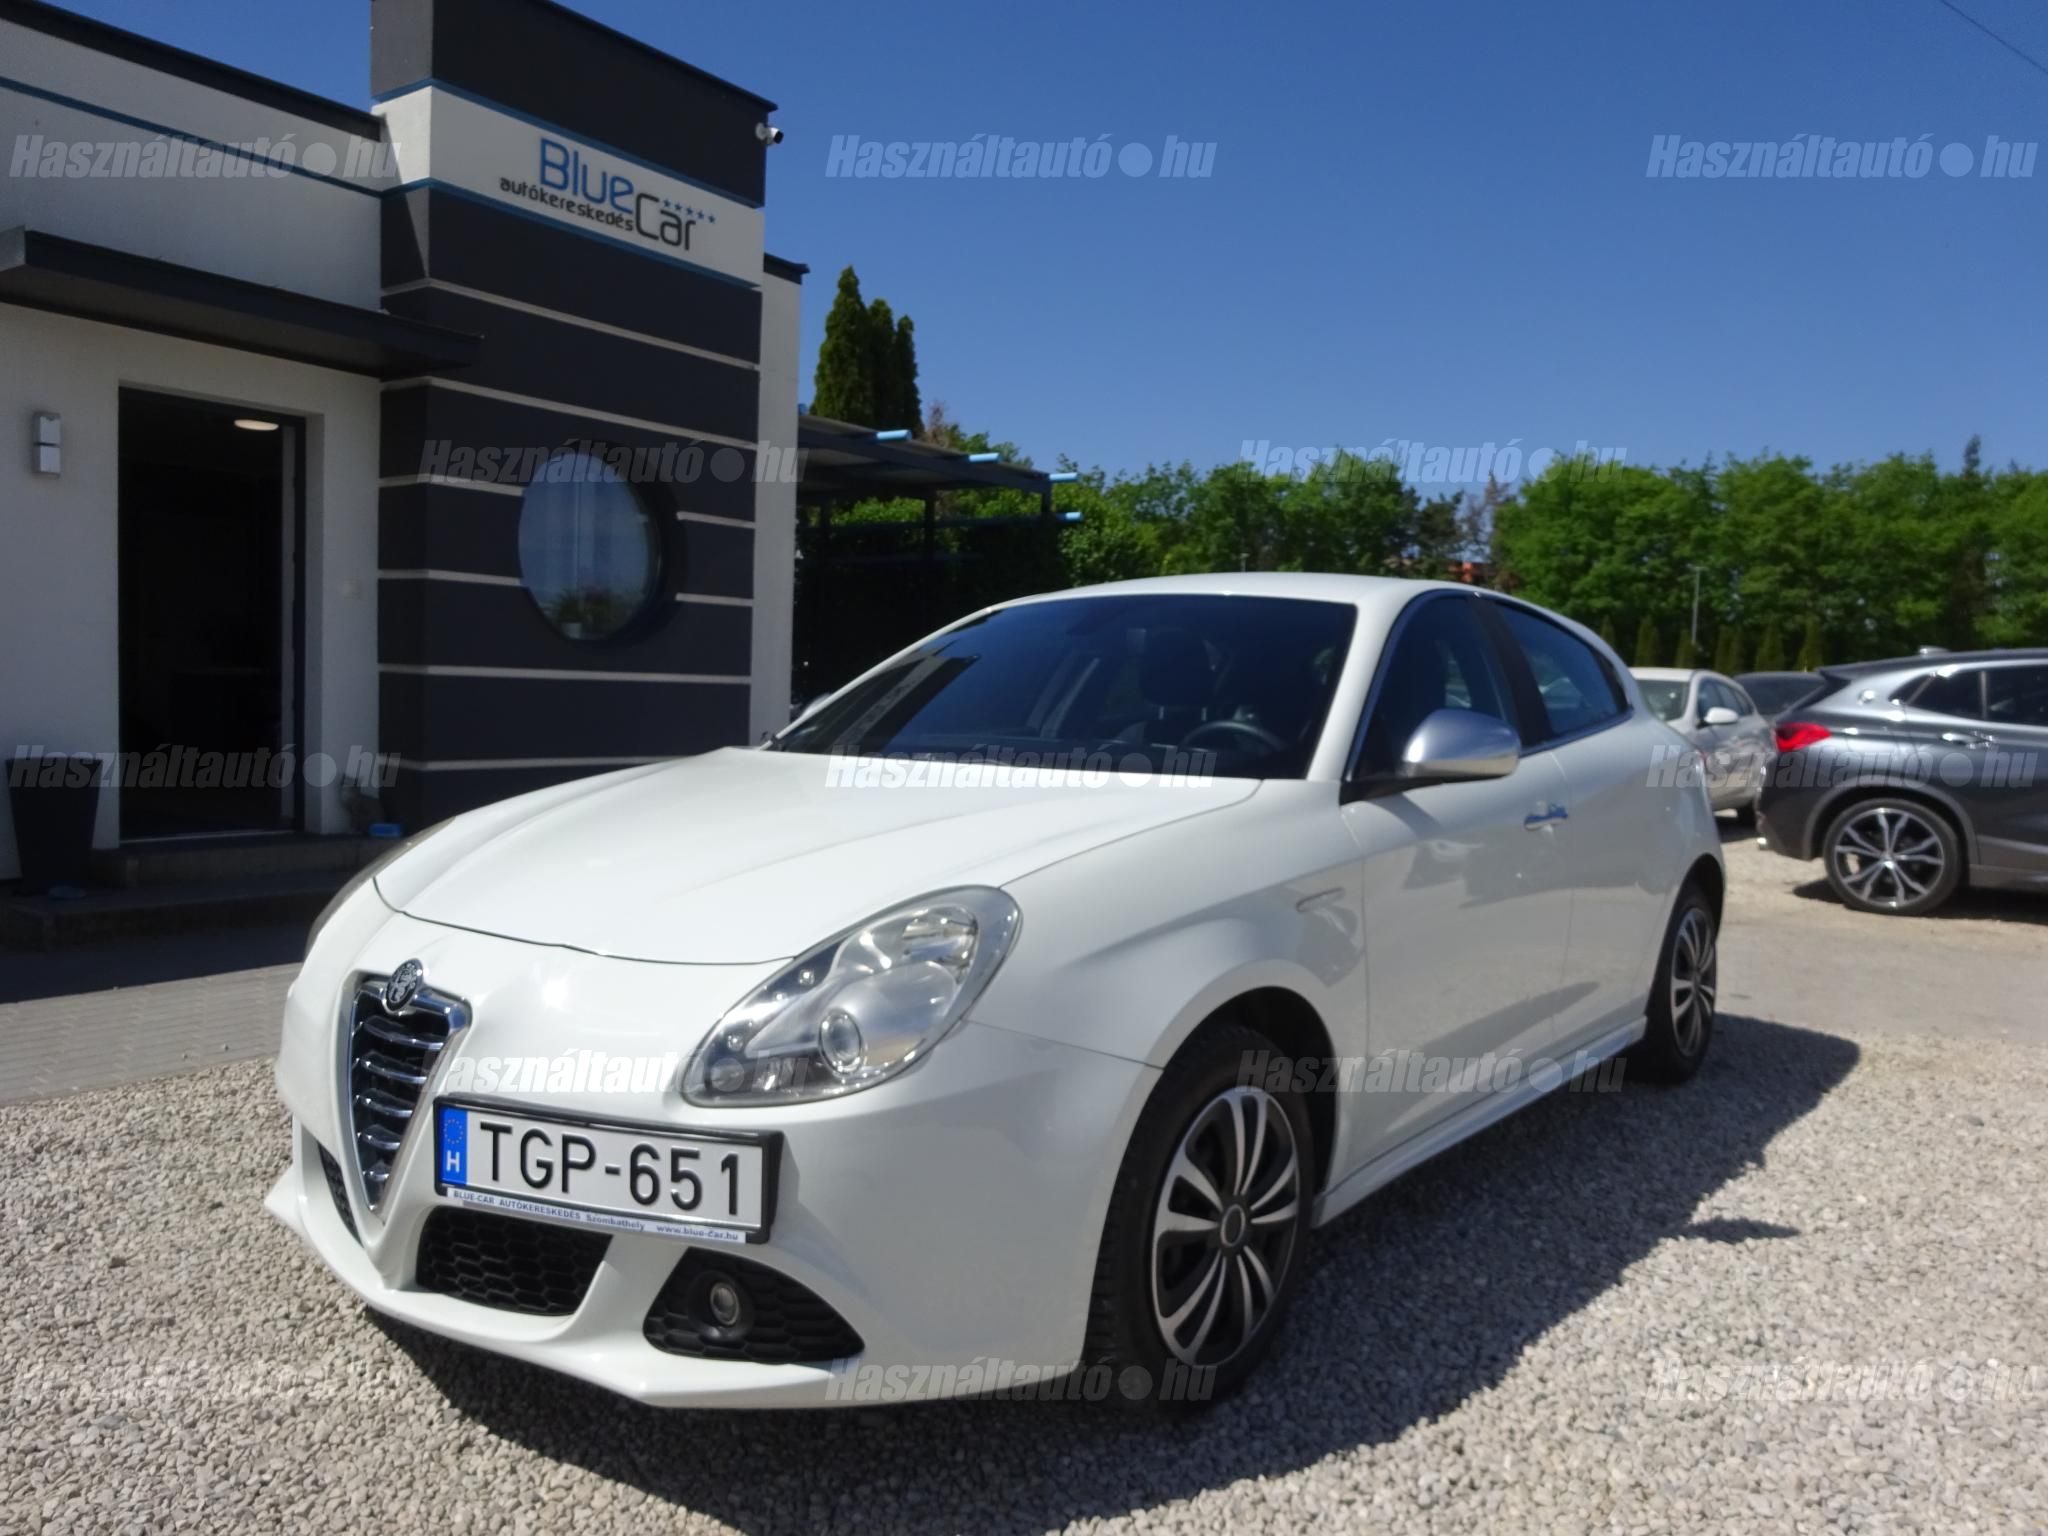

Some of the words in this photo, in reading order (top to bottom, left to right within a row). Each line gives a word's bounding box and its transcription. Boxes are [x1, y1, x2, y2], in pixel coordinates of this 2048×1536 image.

[500, 177, 633, 231] autókereskedés
[446, 1150, 460, 1173] H
[480, 1120, 739, 1216] TGP-651
[585, 1213, 645, 1232] Szombathely
